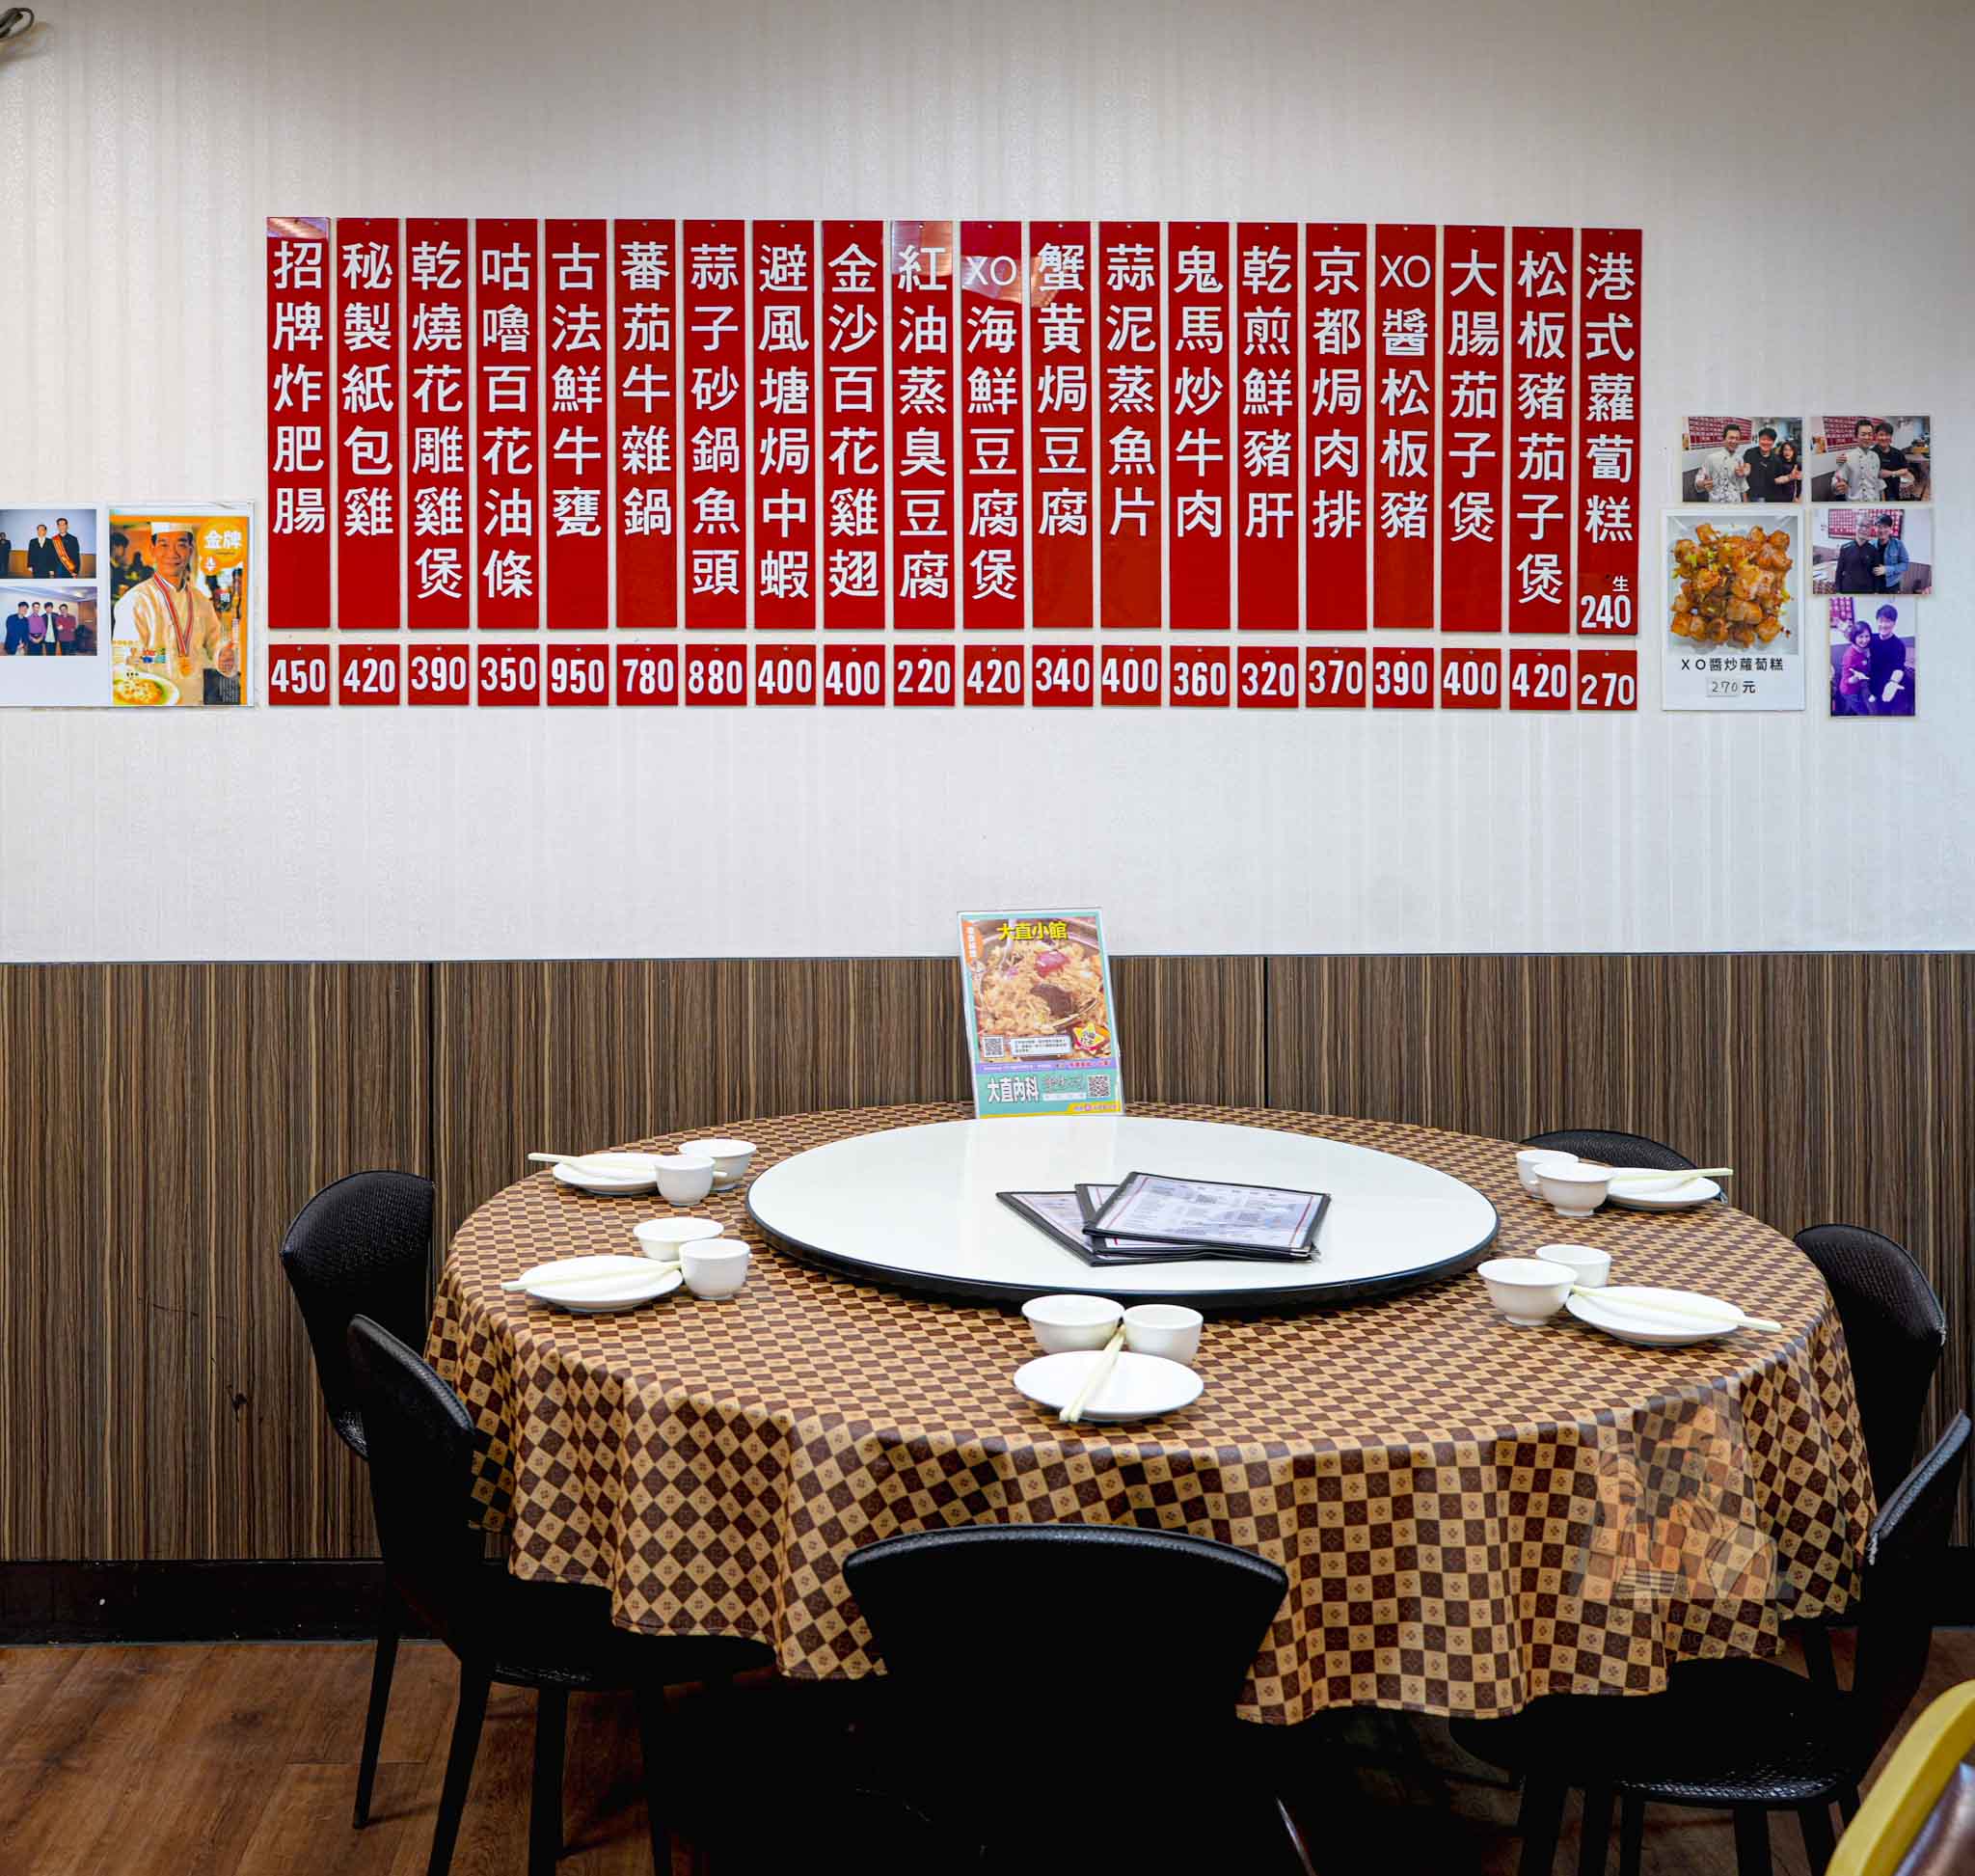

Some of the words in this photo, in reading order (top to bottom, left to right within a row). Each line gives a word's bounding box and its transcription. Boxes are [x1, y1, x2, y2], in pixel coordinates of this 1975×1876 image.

[273, 241, 324, 533] 招牌炸肥腸
[342, 242, 393, 535] 秘製紙包雞
[553, 243, 602, 536] 古法鮮牛甕
[621, 241, 671, 534] 蕃茄牛雜鍋
[1106, 244, 1155, 535] 蒜泥蒸魚片
[1175, 246, 1223, 537] 鬼馬炒牛肉
[1243, 246, 1293, 537] 乾煎鮮豬肝
[1312, 246, 1361, 537] 京都焗肉排
[1448, 250, 1499, 541] 大腸茄子煲
[1585, 253, 1635, 543] 港式蘿蔔糕
[412, 241, 464, 598] 乾燒花雕雞煲
[483, 243, 532, 598] 咕嚕百花油條
[691, 244, 740, 594] 蒜子砂鍋魚頭
[759, 244, 809, 598] 避風塘焗中蝦
[828, 244, 879, 597] 金沙百花雞翅
[897, 244, 949, 599] 紅油蒸臭豆腐
[1517, 251, 1566, 604] 松板豬茄子煲
[1612, 575, 1630, 591] 生
[1581, 594, 1632, 629] 240
[272, 660, 325, 693] 450
[343, 659, 394, 693] 420
[412, 656, 466, 691] 390
[481, 657, 535, 692] 350
[552, 659, 604, 693] 950
[623, 659, 673, 693] 780
[689, 660, 742, 694] 880
[758, 660, 811, 693] 400
[825, 660, 879, 695] 400
[898, 659, 950, 693] 220
[967, 660, 1020, 693] 420
[1036, 658, 1089, 692] 340
[1102, 659, 1157, 693] 400
[1174, 663, 1226, 695] 360
[1242, 662, 1294, 696] 320
[1310, 661, 1363, 693] 370
[1376, 661, 1427, 695] 390
[1444, 662, 1497, 695] 400
[1512, 664, 1566, 697] 420
[1582, 673, 1634, 706] 270
[1743, 680, 1755, 693] 元
[997, 921, 1069, 940] 大直小館
